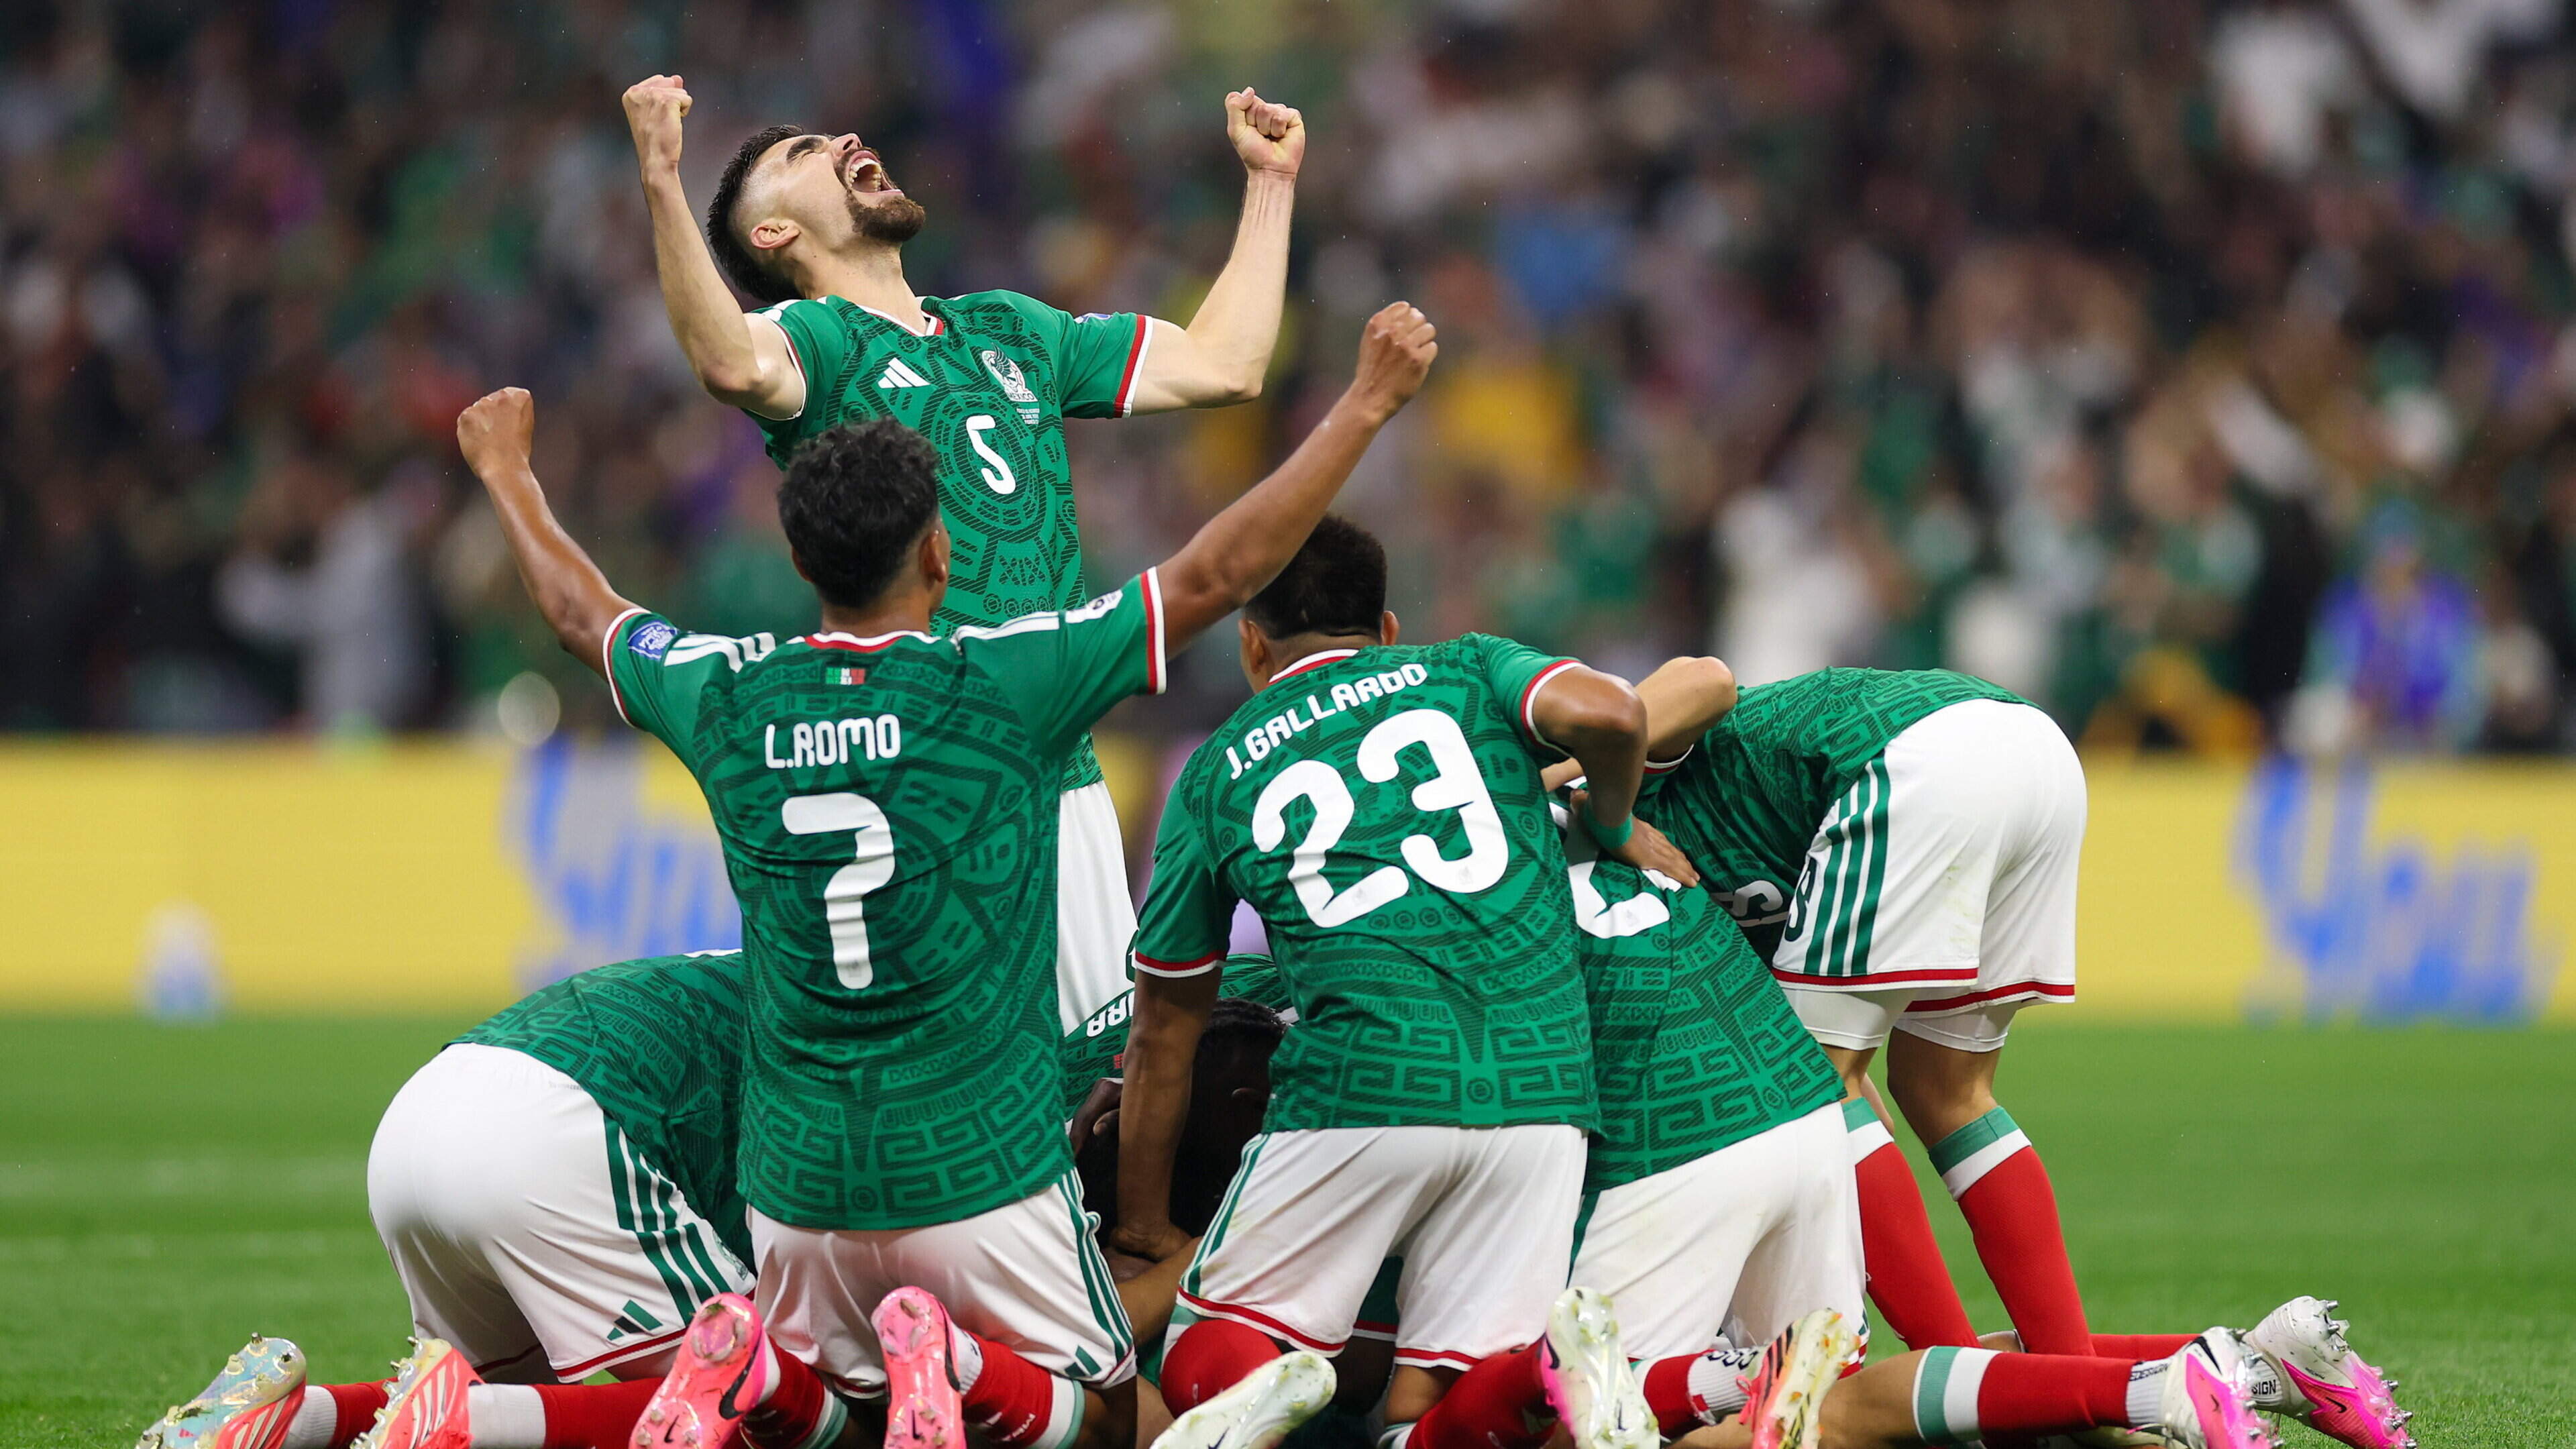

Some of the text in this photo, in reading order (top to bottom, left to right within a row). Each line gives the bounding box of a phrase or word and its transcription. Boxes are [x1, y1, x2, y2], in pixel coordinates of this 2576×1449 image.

[965, 414, 1016, 495] 5
[764, 713, 902, 769] L.ROMO
[1225, 663, 1428, 780] J.GALLARDO
[1252, 708, 1509, 928] 23
[782, 792, 896, 990] 7
